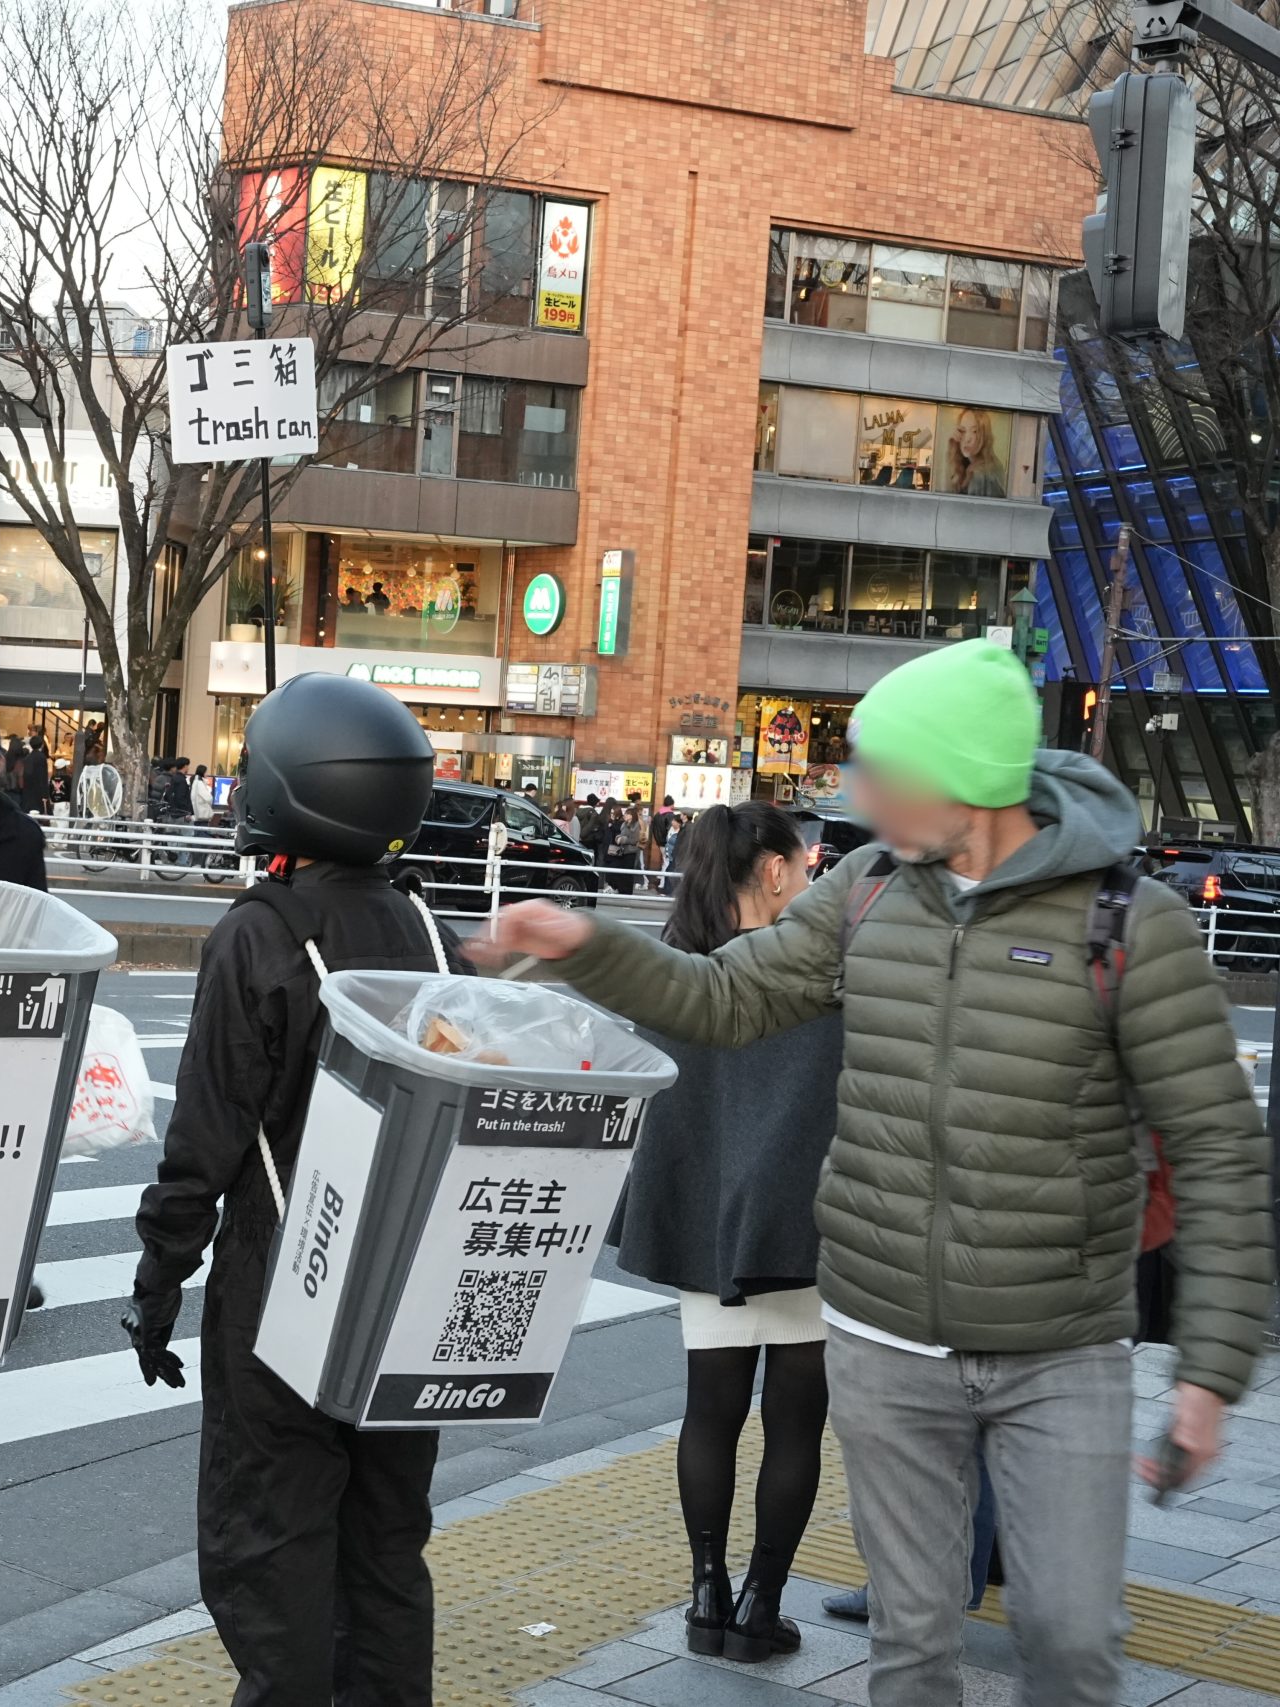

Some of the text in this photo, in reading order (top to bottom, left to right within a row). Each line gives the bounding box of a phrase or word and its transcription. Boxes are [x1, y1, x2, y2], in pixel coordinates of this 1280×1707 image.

[543, 307, 576, 323] 199円
[544, 296, 577, 309] 生ビール
[185, 343, 298, 393] ゴミ箱
[188, 406, 317, 445] trash can.
[625, 779, 650, 787] 生ビール
[481, 1088, 605, 1113] ゴミを入れて!!
[476, 1117, 566, 1133] Put in the trash!
[458, 1176, 567, 1215] 広告主
[304, 1181, 344, 1299] BinGo
[462, 1220, 592, 1258] 募集中!!
[413, 1382, 506, 1409] BinGo
